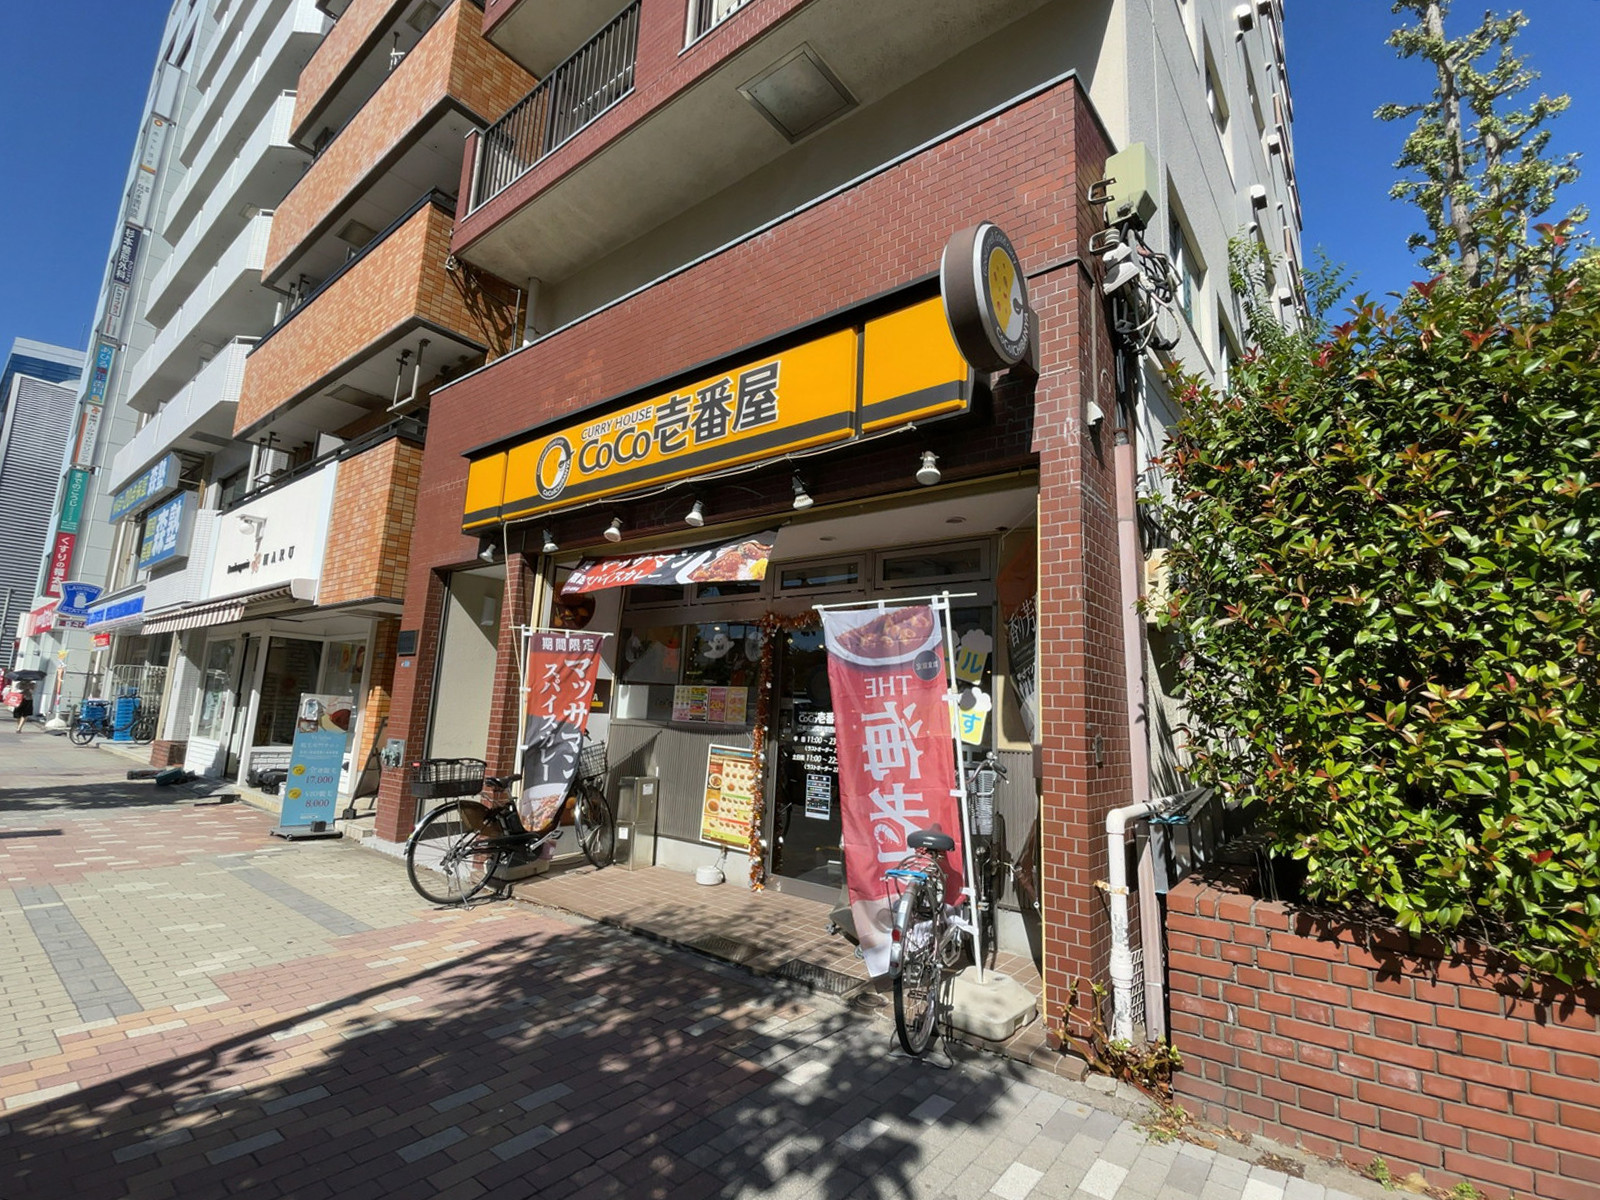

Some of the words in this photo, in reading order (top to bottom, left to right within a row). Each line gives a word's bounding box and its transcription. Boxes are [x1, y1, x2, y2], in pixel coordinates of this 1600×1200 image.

[578, 360, 781, 475] CoCo壱番屋
[581, 419, 612, 440] CURRY
[614, 405, 654, 429] HOUSE
[542, 636, 595, 652] 期間限定
[540, 663, 561, 782] スパイスカレー
[561, 656, 593, 780] マッサマン
[799, 712, 835, 724] CoCo壱番
